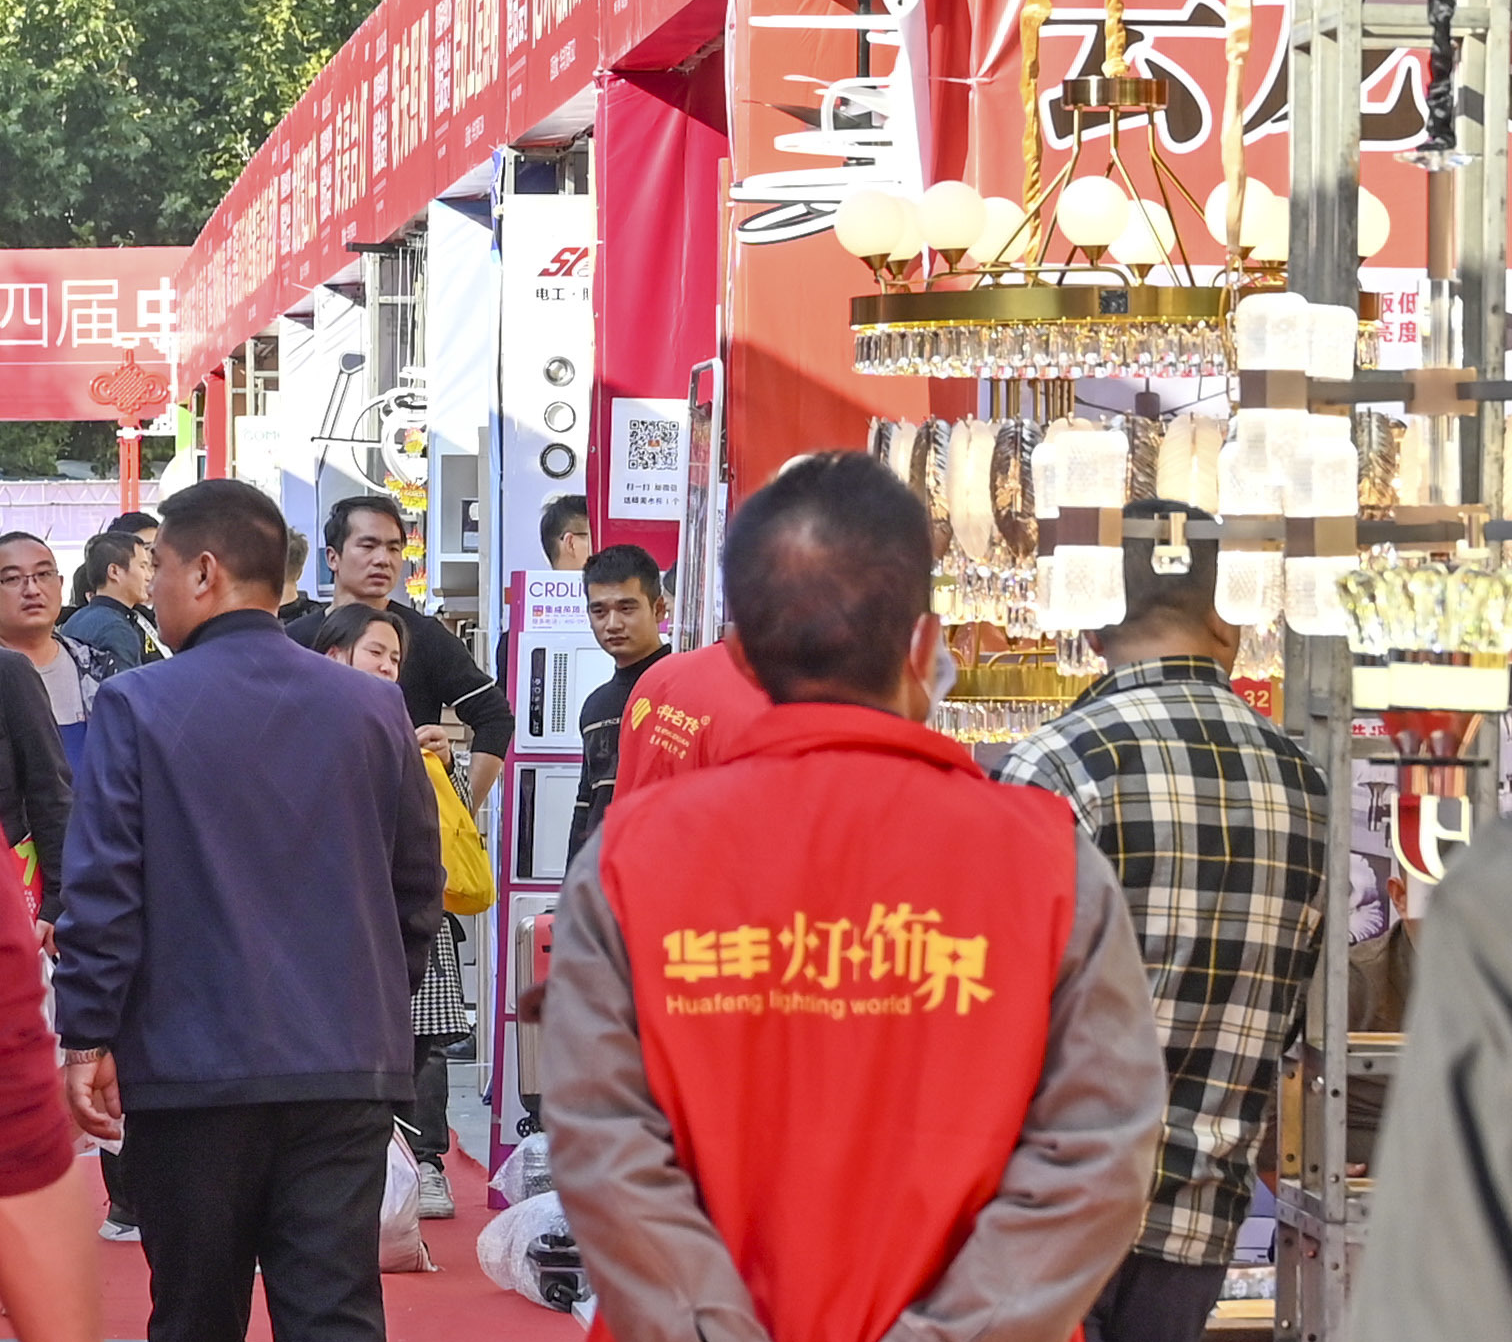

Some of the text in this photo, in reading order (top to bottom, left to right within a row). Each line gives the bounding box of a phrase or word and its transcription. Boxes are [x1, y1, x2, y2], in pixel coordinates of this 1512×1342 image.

[663, 902, 994, 1016] 华丰灯饰界
[666, 989, 912, 1020] Huafeng lighting world
